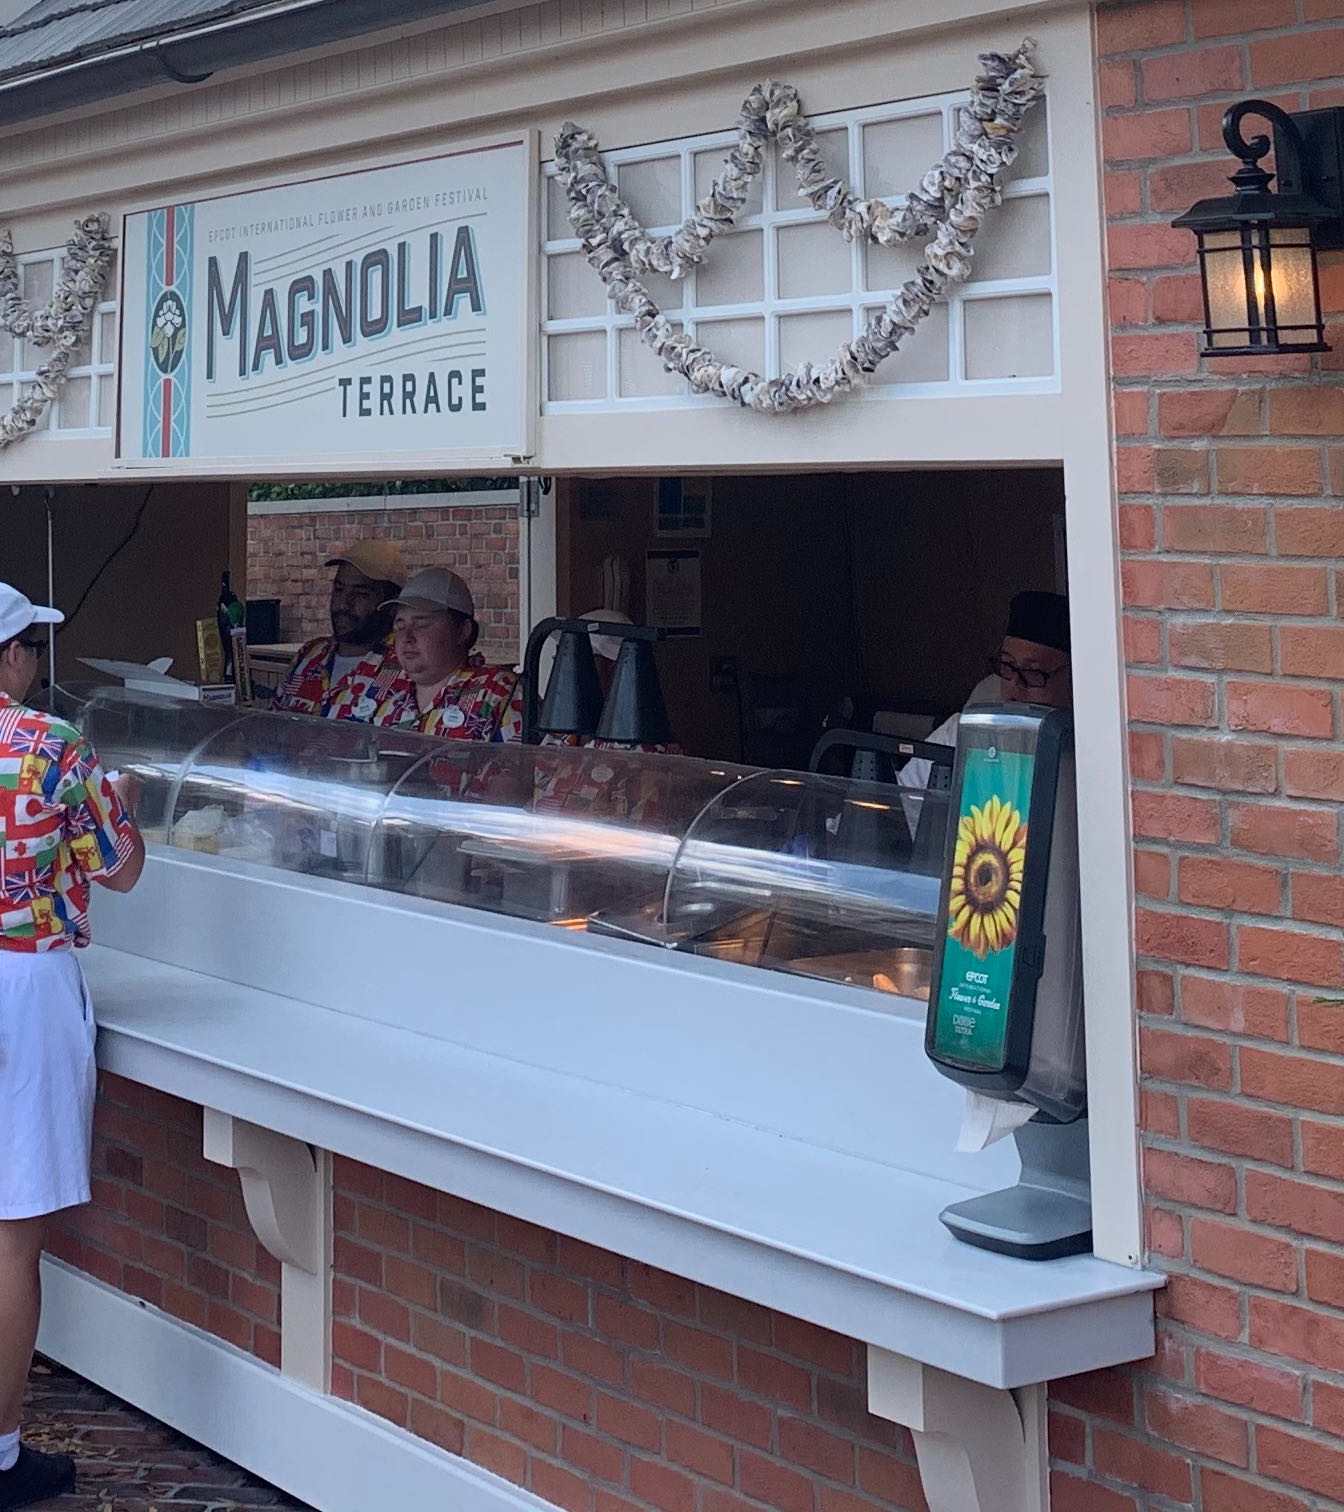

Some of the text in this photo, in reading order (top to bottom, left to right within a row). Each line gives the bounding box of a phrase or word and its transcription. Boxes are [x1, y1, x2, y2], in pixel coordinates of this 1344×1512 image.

[208, 187, 489, 244] EPCOT INTERNATIONAL FLOWER AND GARDEN FESTIVAL
[205, 224, 487, 382] MAGNOLIA
[338, 368, 487, 418] TERRACE
[966, 971, 989, 984] EPCOT
